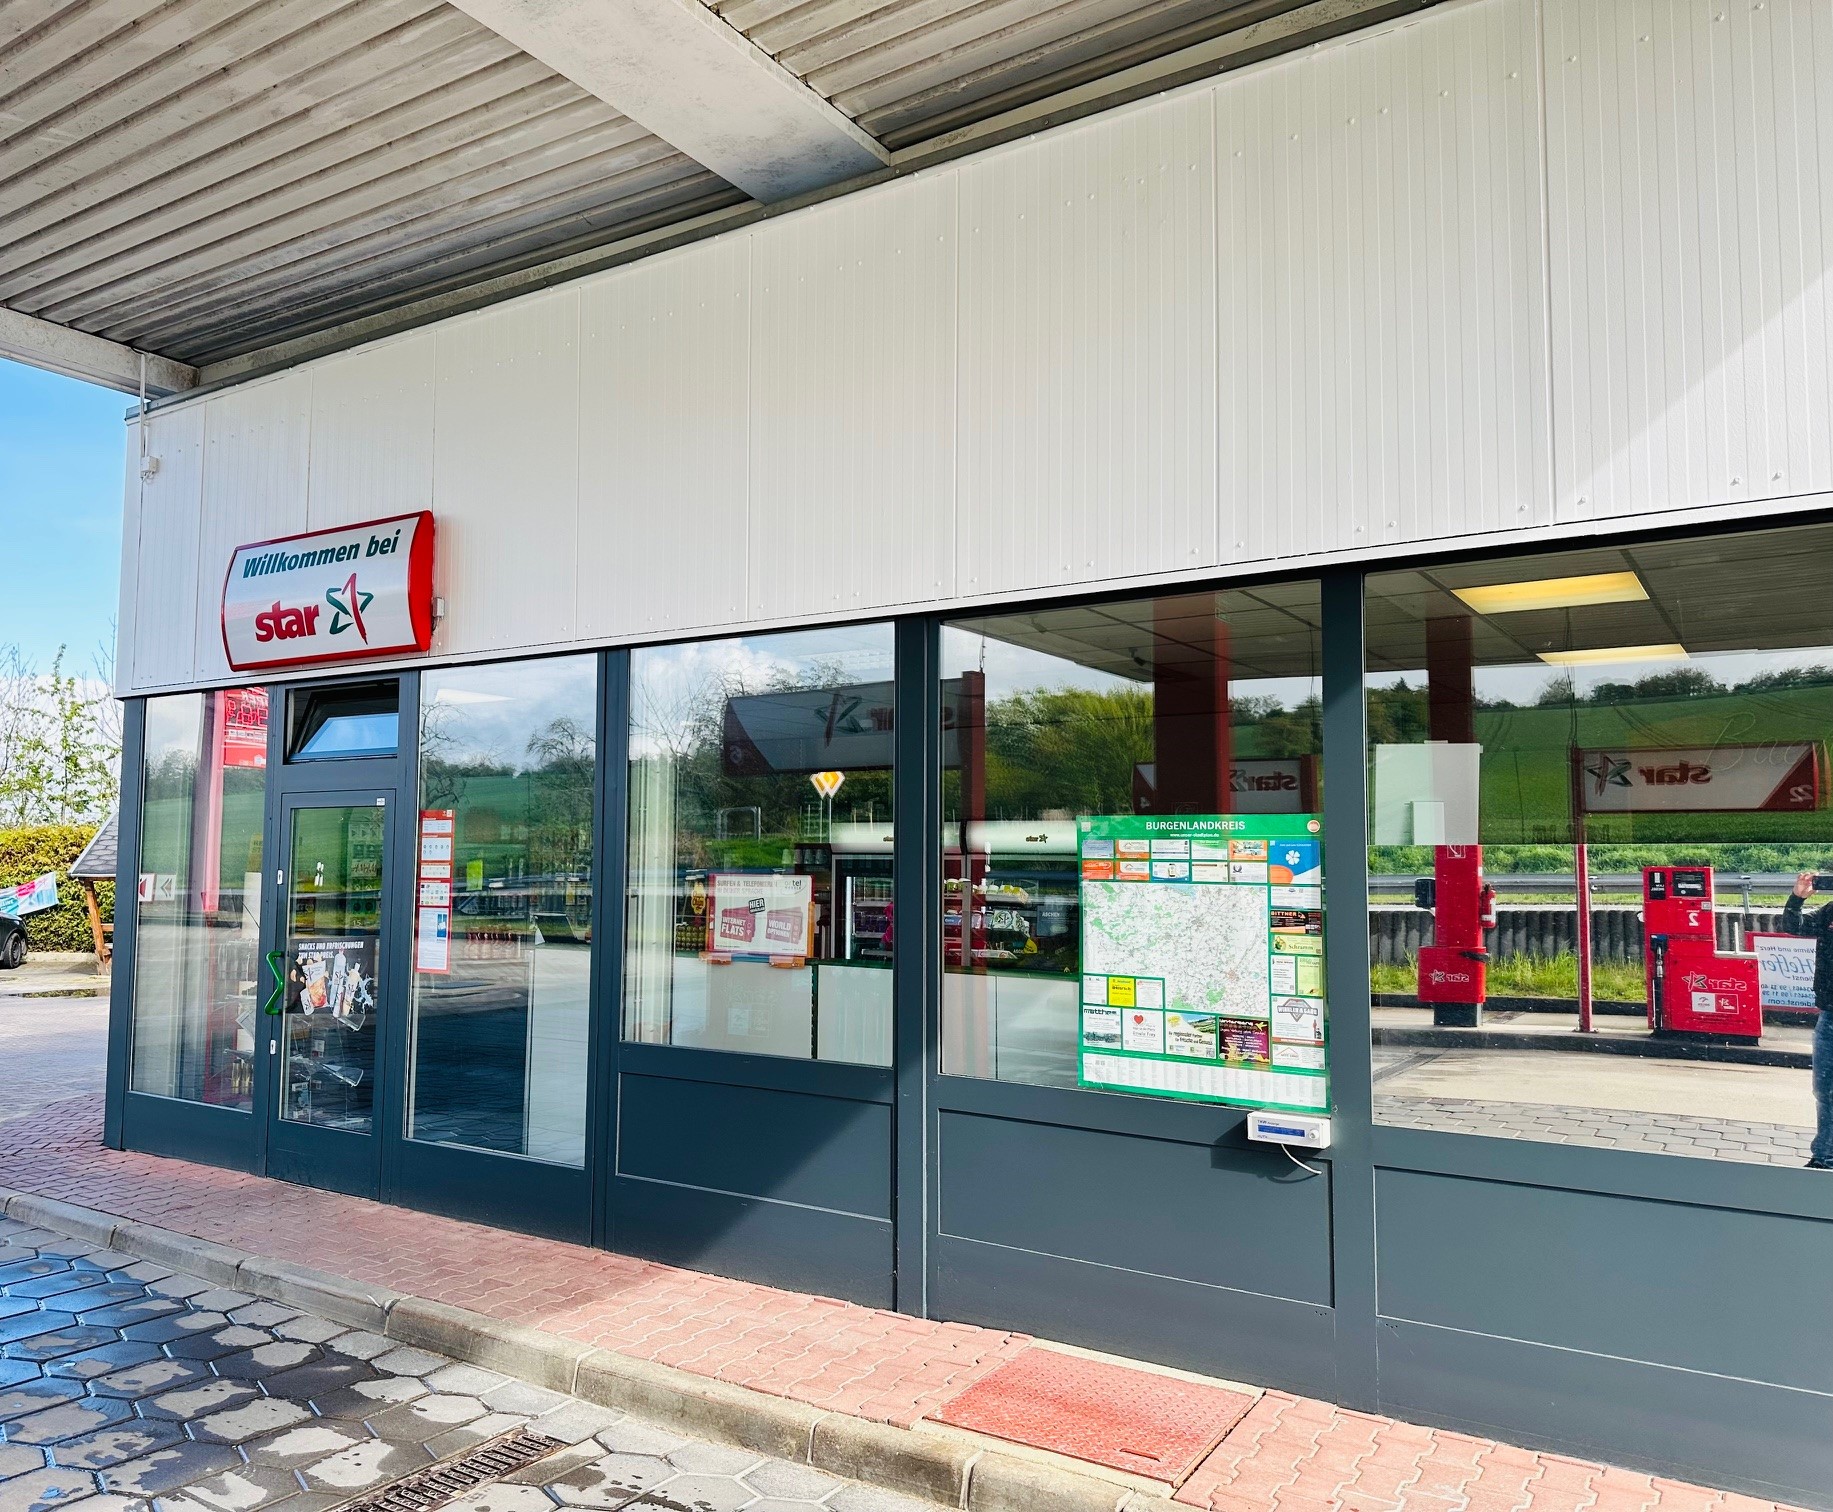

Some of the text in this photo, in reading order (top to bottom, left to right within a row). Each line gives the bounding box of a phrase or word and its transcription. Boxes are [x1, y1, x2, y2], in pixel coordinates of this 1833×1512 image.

[242, 529, 402, 578] Willkommen bei
[255, 600, 320, 642] star
[1145, 820, 1246, 831] BURGENLANDKREIS
[749, 898, 764, 909] HIER
[721, 923, 745, 937] FLATS
[768, 919, 791, 930] WORLD
[298, 943, 316, 951] SNACKS
